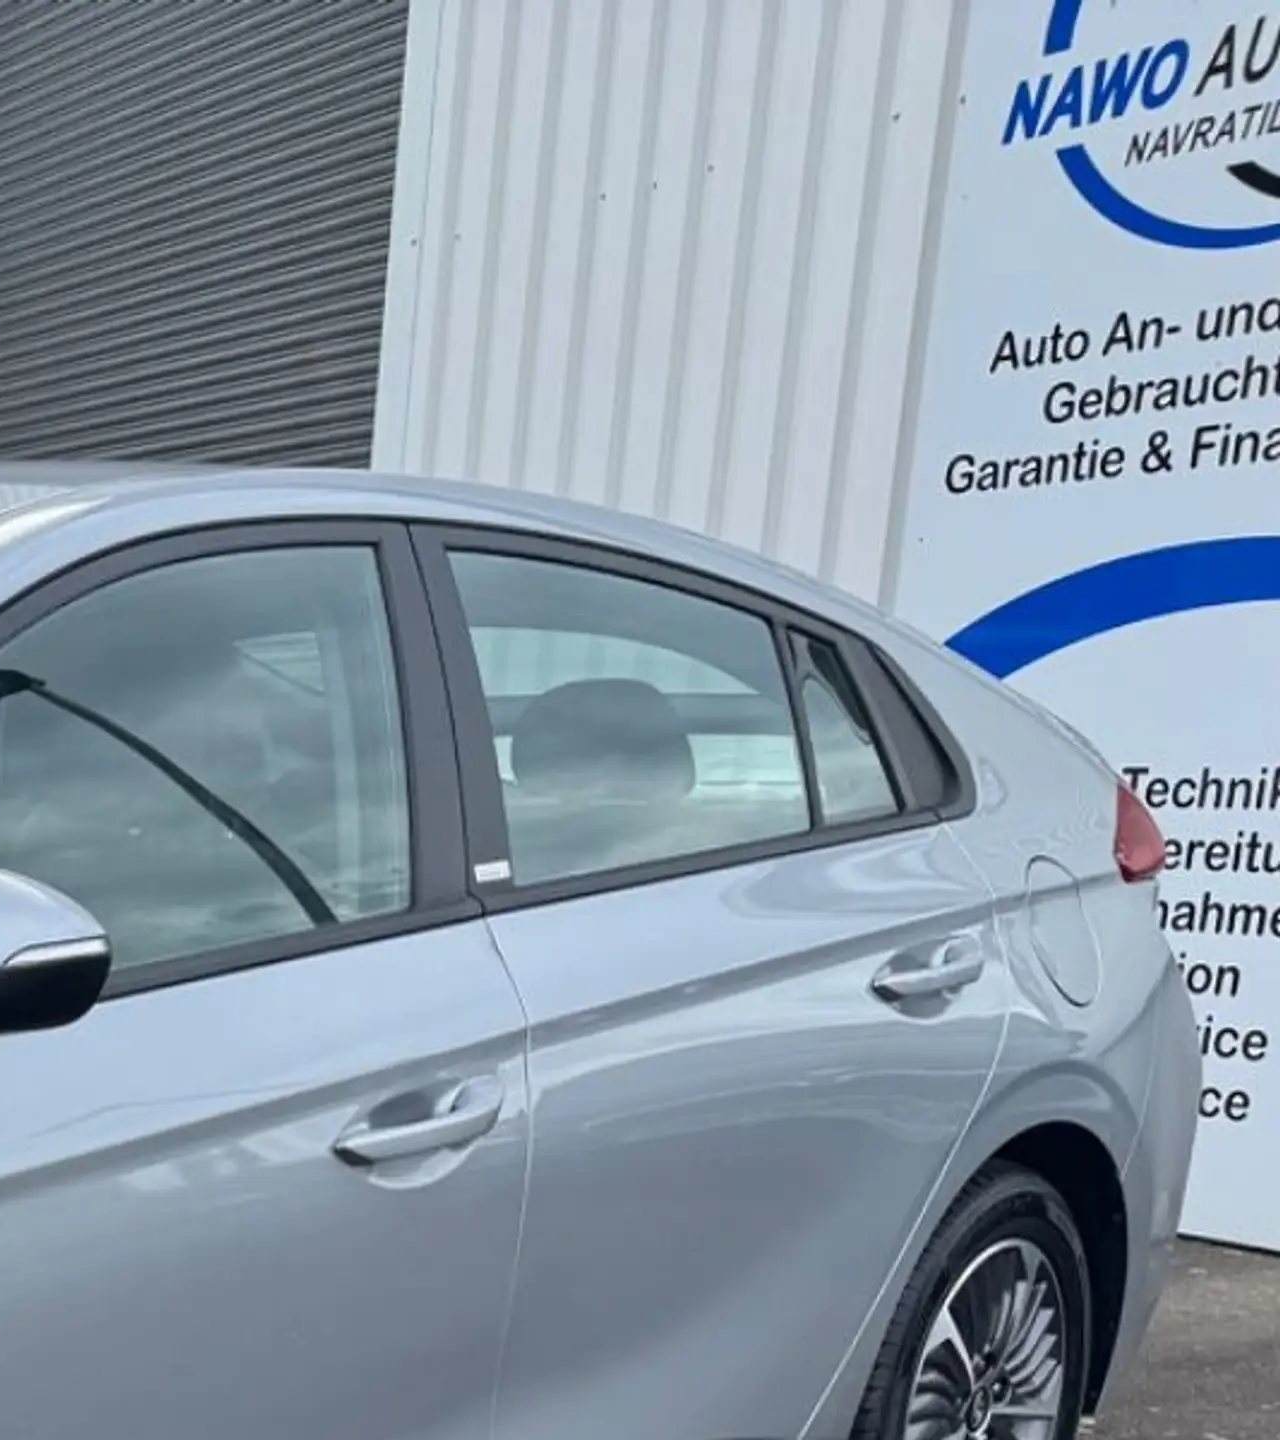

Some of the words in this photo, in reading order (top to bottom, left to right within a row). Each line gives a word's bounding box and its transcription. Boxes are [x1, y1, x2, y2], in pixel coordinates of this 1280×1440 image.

[1001, 38, 1189, 145] NAWO
[1193, 16, 1280, 96] AU
[989, 323, 1089, 374] Auto
[1102, 311, 1181, 357] An-
[946, 440, 1125, 493] Garantie
[1141, 430, 1173, 474] &
[1197, 1014, 1268, 1061] ice
